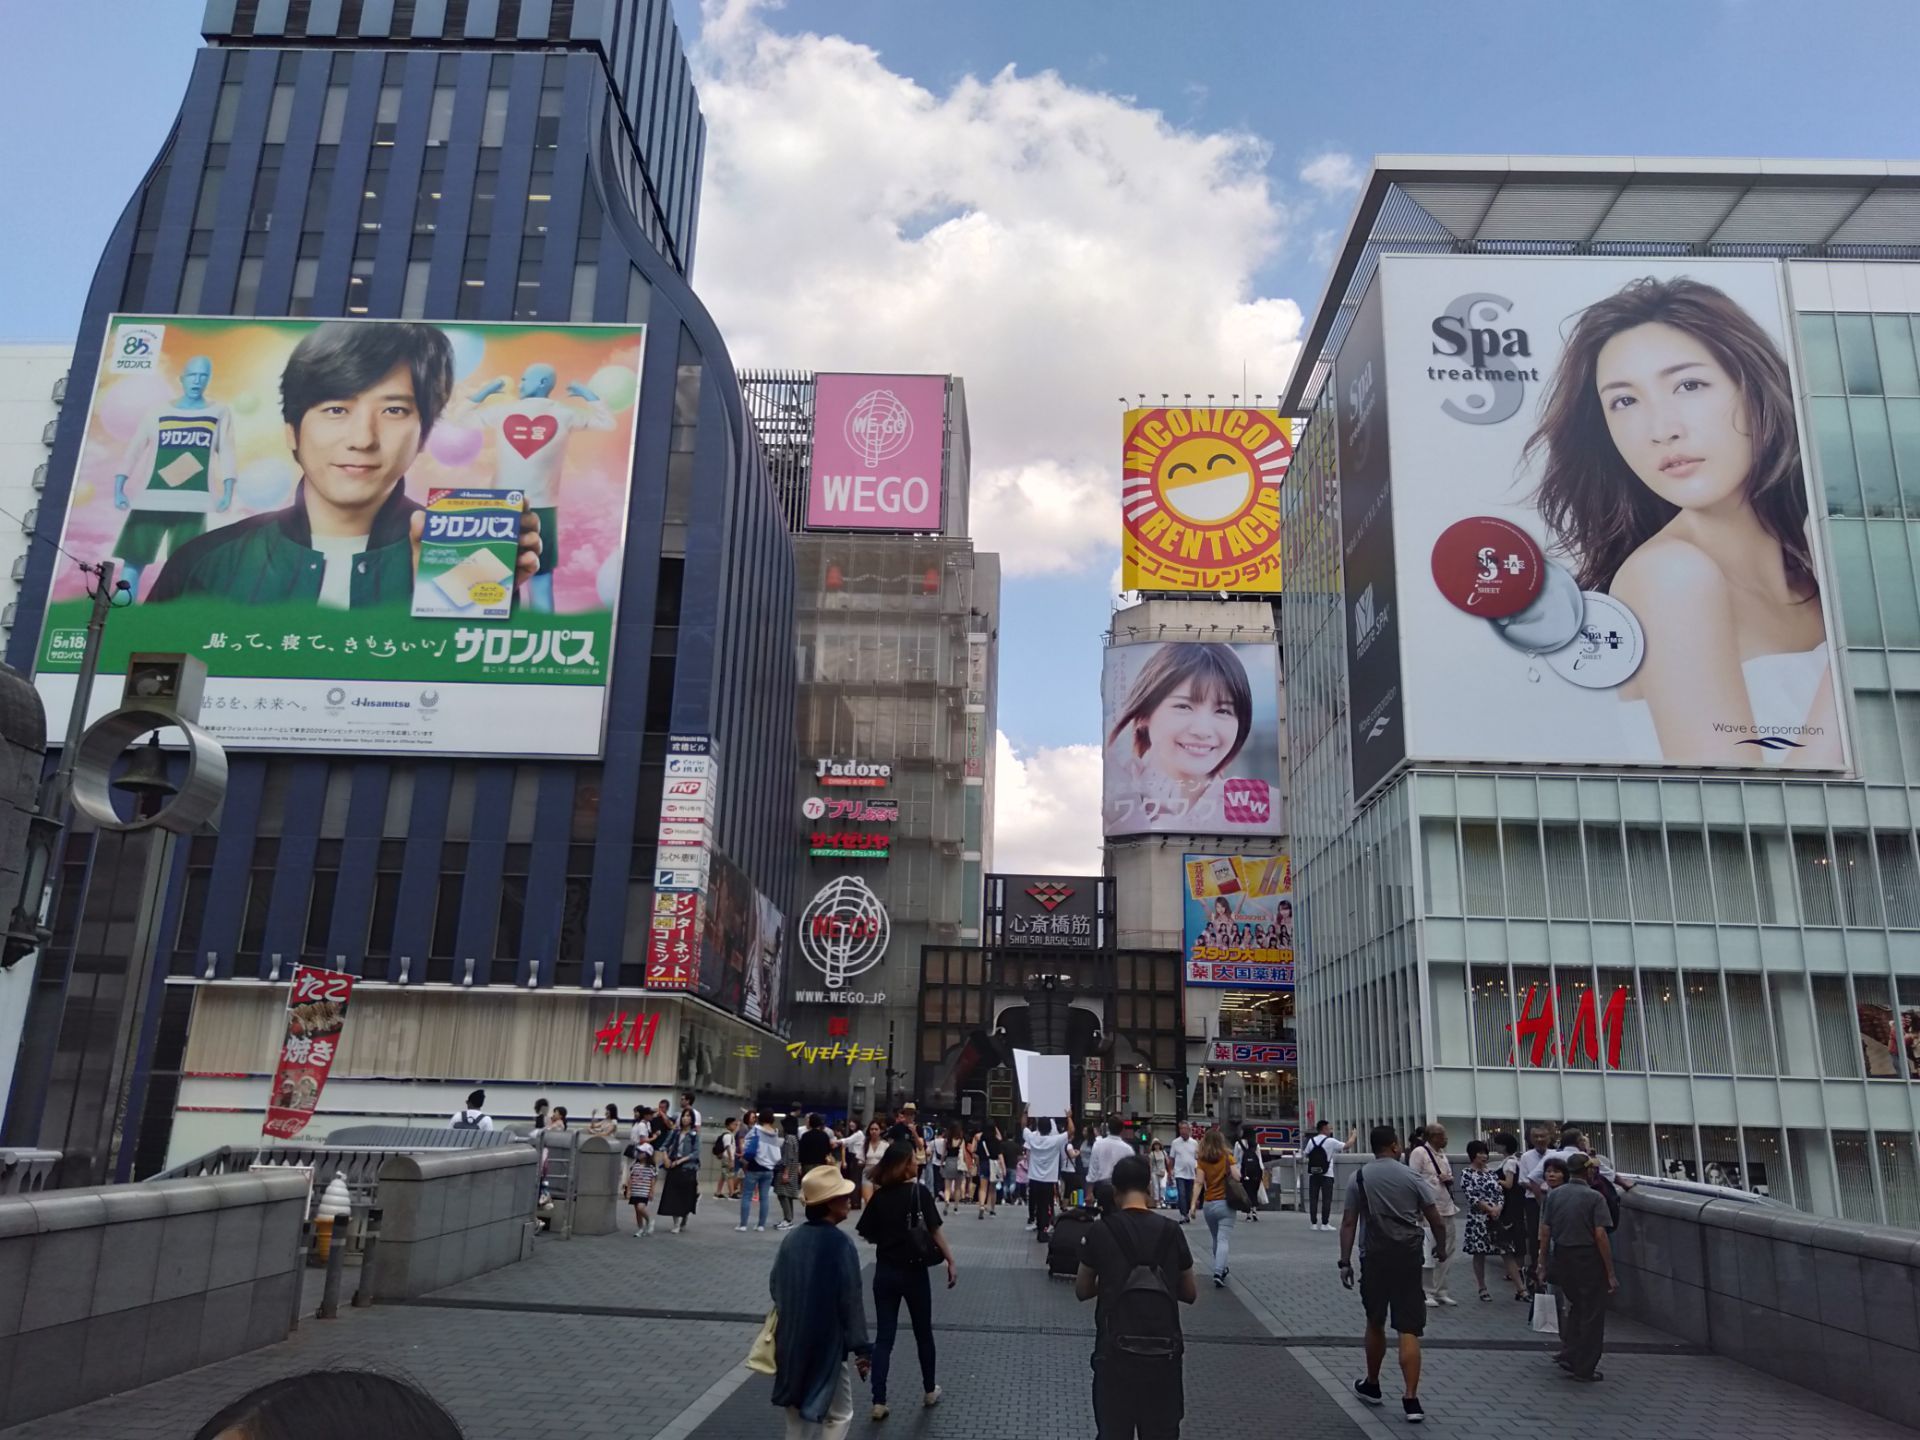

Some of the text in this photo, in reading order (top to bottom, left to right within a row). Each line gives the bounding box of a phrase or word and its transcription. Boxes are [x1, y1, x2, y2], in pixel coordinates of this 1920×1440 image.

[123, 336, 150, 355] 85
[1432, 316, 1532, 367] Spa
[117, 359, 152, 369] サロンパス
[1427, 366, 1539, 381] treatment
[161, 431, 212, 447] サロンパス
[513, 426, 546, 440] 二宮
[1125, 408, 1271, 473] NICONICO
[823, 475, 929, 513] WEGO
[429, 515, 515, 538] サロンパス
[1139, 487, 1280, 561] RENTACAR
[1126, 545, 1280, 588] ニコニコレンタカ
[53, 635, 87, 649] 5月18
[454, 628, 595, 666] サロンパス
[351, 697, 411, 709] Hisamitsu
[1712, 723, 1824, 736] Wave corporation
[816, 759, 890, 777] J'adore
[672, 783, 700, 793] TKP
[807, 803, 821, 815] 7F
[811, 832, 889, 849] サイゼリヤ
[673, 894, 693, 978] インターネット
[651, 929, 669, 977] コミック
[1216, 966, 1294, 981] 大国薬粧
[299, 974, 348, 1002] たこ
[795, 991, 887, 1004] WWW.WEGO.JP
[594, 1012, 660, 1056] H&M
[1506, 984, 1627, 1070] H&M
[284, 1035, 334, 1067] 焼き
[786, 1041, 888, 1065] マツモトキヨシ
